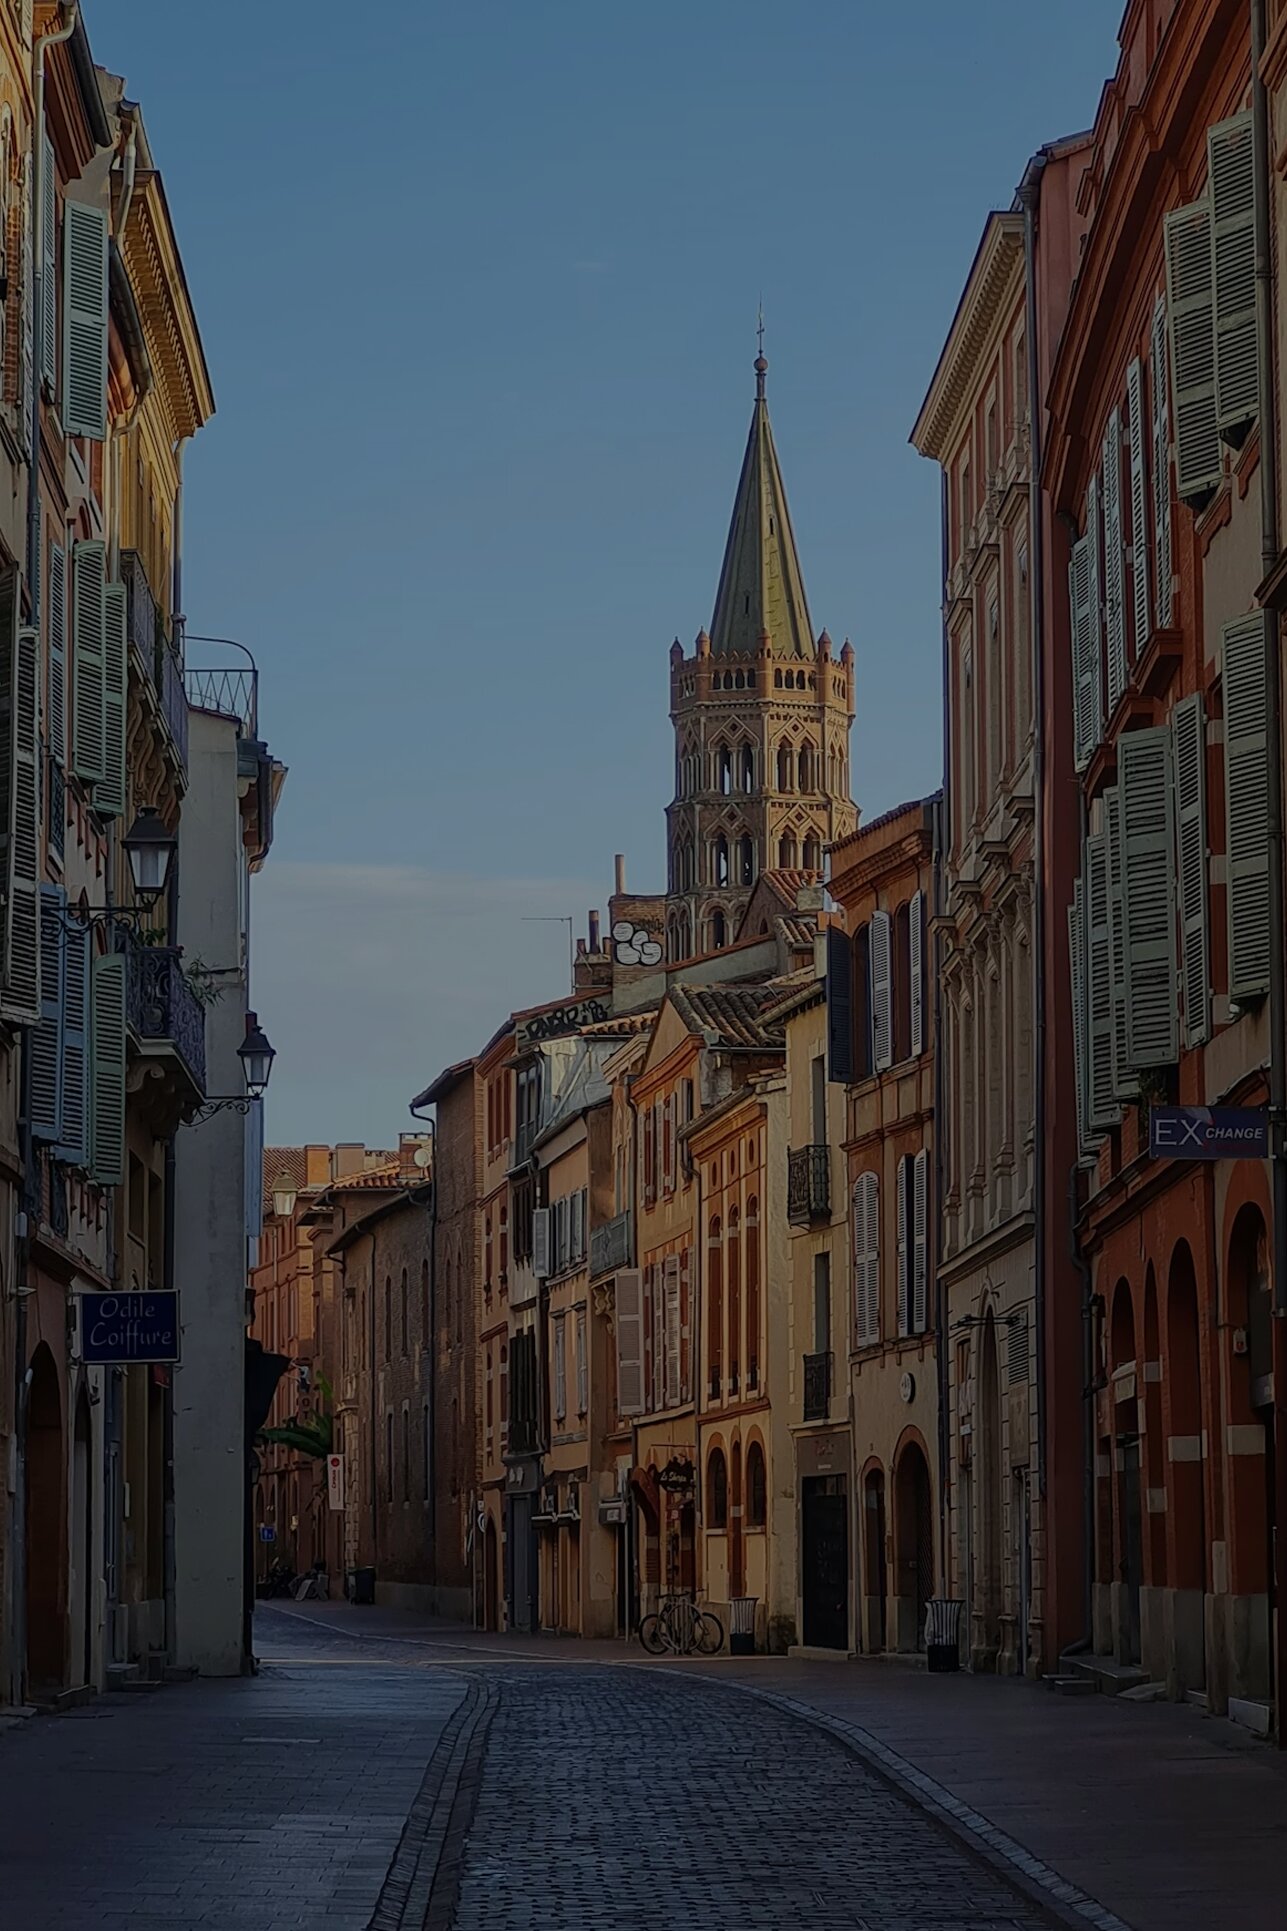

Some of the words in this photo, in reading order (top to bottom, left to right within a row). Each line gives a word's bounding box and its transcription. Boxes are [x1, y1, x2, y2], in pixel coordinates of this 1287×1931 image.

[1155, 1119, 1203, 1146] EX
[1205, 1127, 1264, 1139] CHANGE
[99, 1295, 156, 1318] Odile
[90, 1320, 172, 1355] Coiffure
